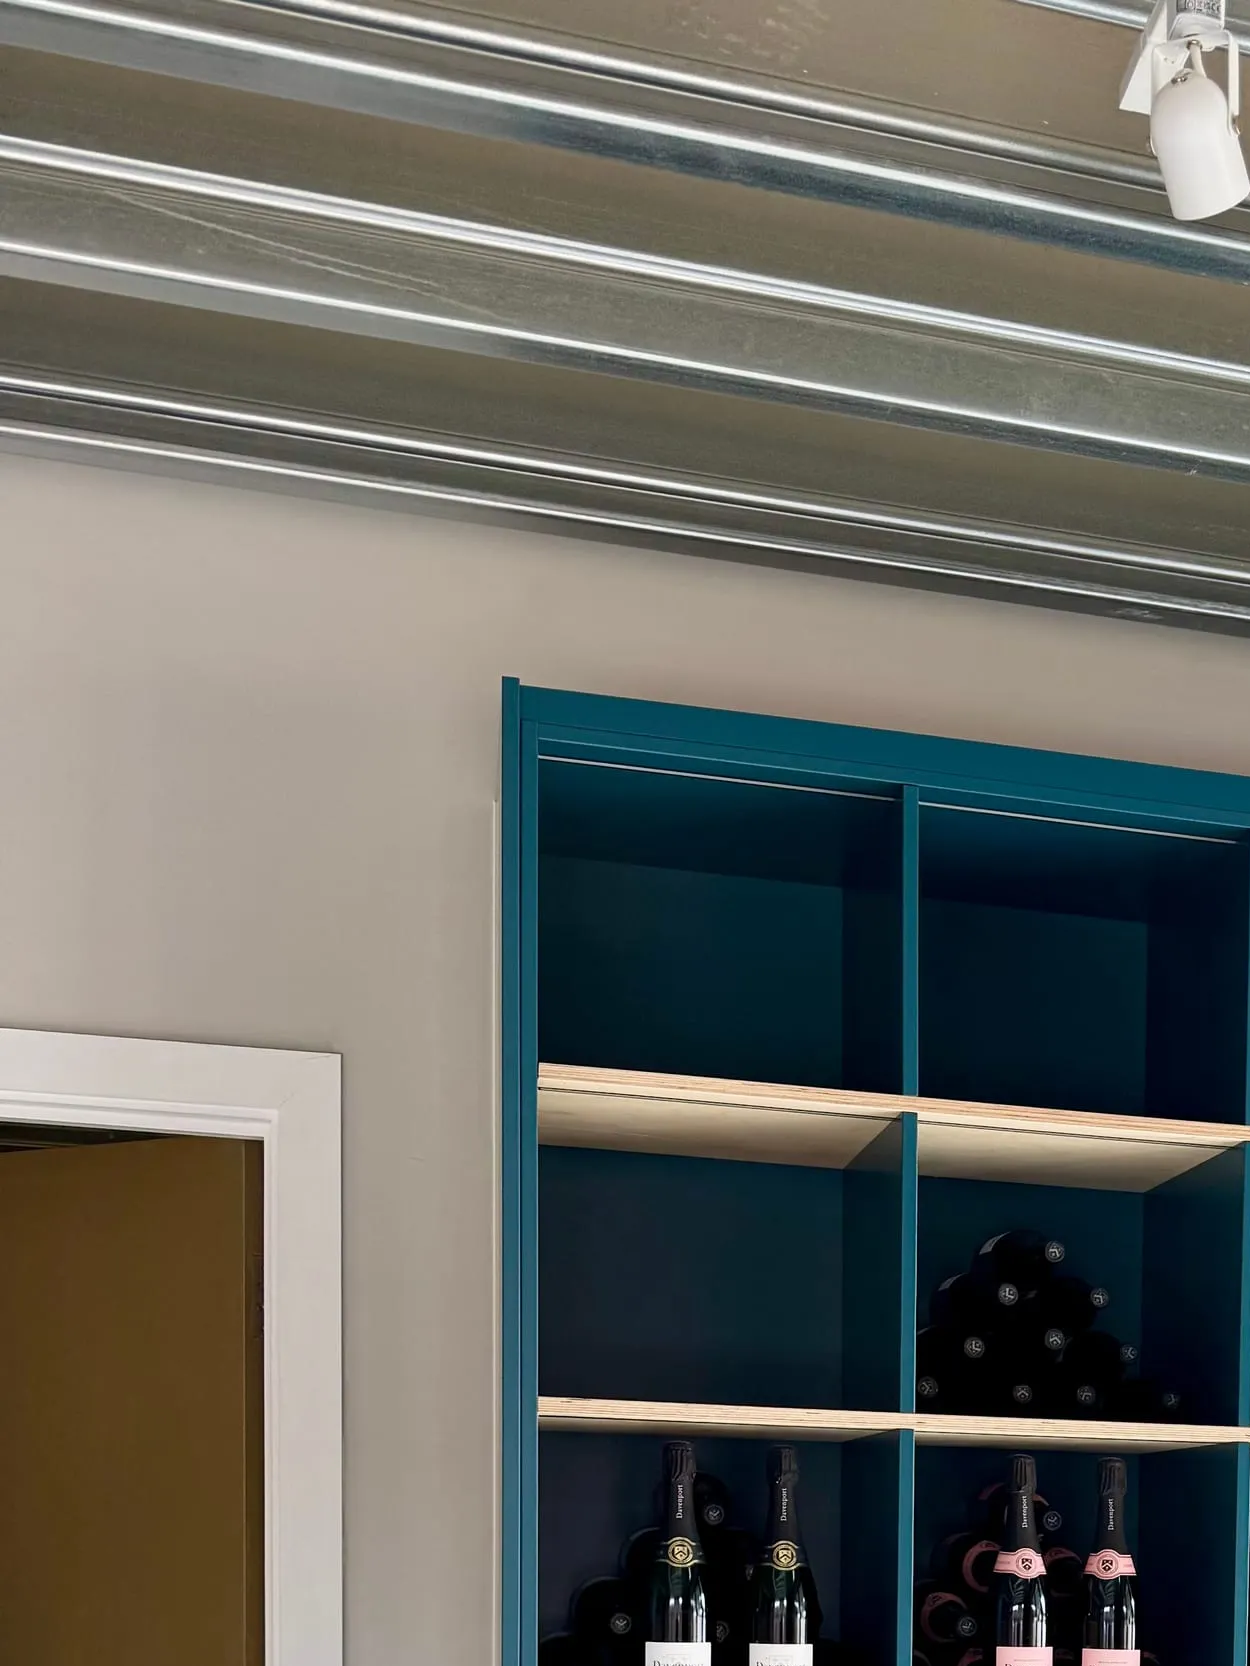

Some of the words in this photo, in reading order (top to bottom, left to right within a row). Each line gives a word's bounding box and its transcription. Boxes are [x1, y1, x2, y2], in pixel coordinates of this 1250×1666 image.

[676, 1485, 684, 1519] Davenport
[780, 1488, 788, 1521] Davenport
[1107, 1498, 1115, 1531] Davenport
